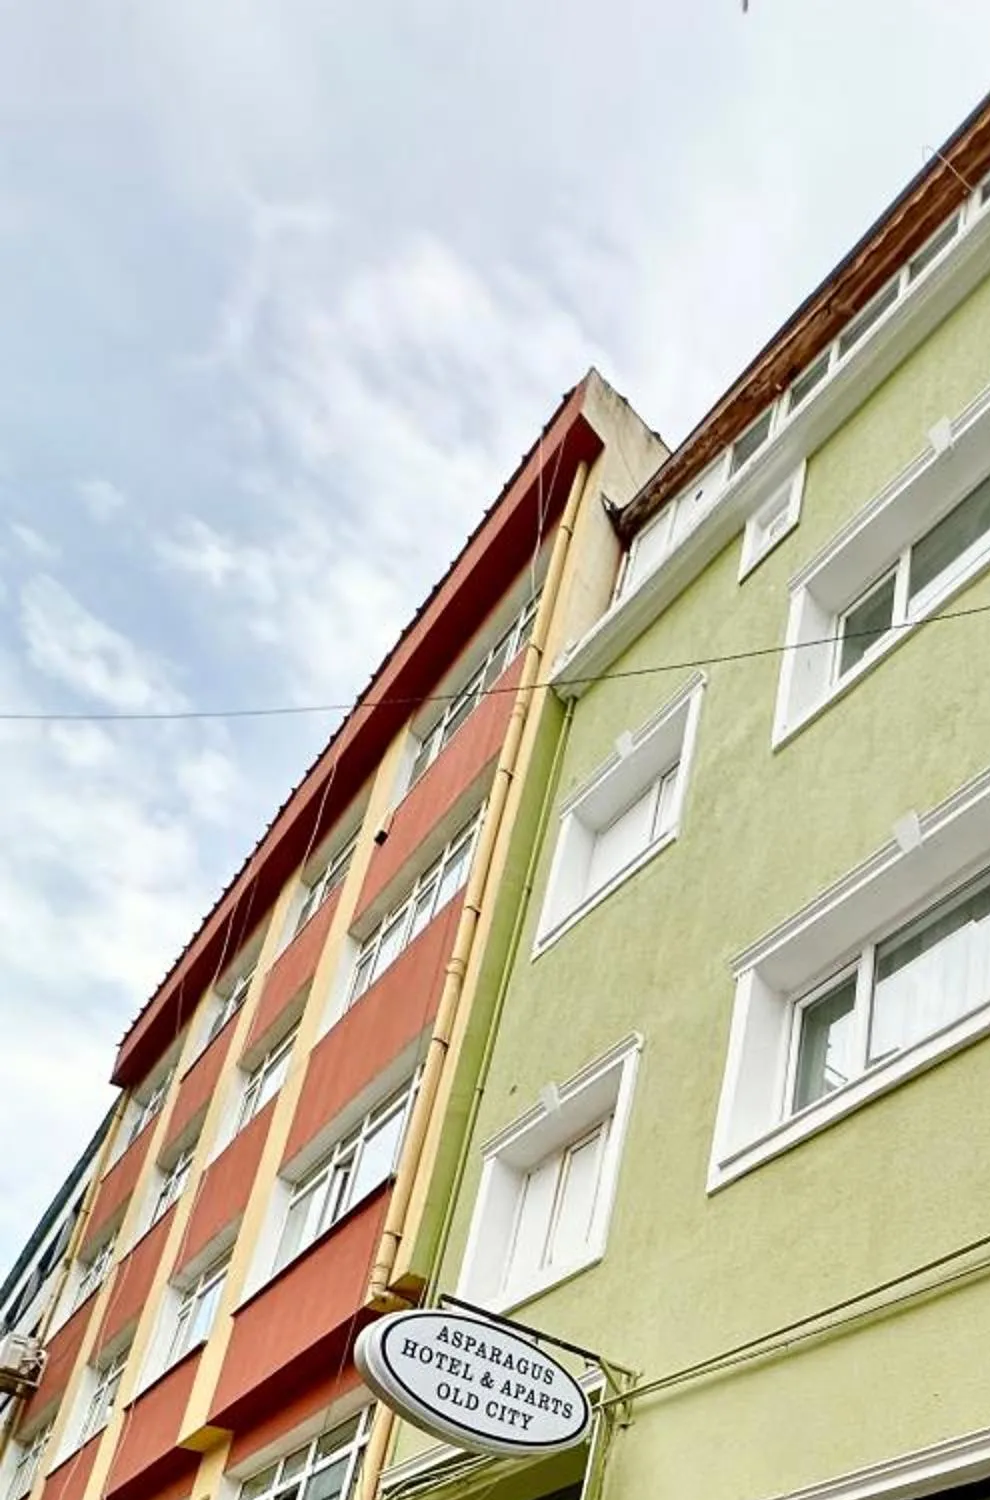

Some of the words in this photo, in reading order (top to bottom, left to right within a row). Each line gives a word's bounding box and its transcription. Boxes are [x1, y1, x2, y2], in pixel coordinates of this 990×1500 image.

[401, 1338, 473, 1381] HOTEL
[479, 1371, 495, 1389] &
[500, 1380, 573, 1420] APARTS
[437, 1326, 554, 1385] ASPARAGUS
[436, 1383, 479, 1411] OLD
[485, 1401, 534, 1430] CITY
